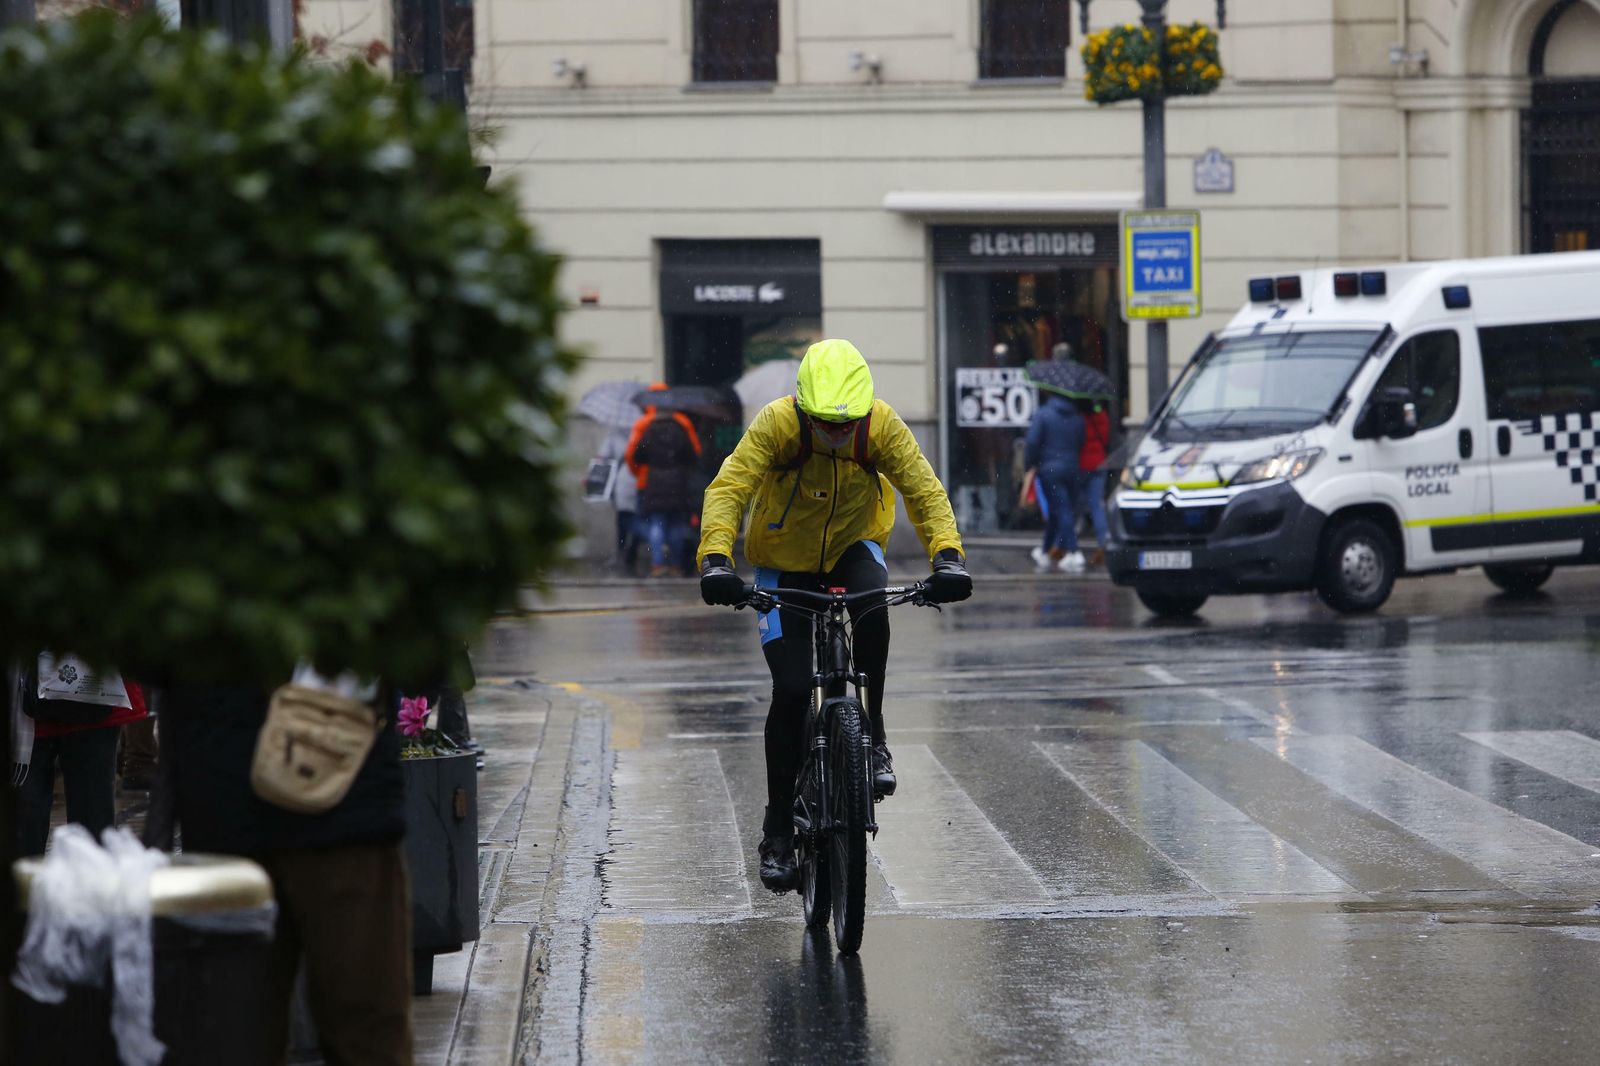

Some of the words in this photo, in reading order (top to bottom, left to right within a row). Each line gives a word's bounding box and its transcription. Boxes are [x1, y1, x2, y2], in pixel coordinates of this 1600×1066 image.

[1142, 267, 1184, 283] TAXI
[694, 285, 755, 301] LACOSTE
[1408, 483, 1451, 497] LOCAL
